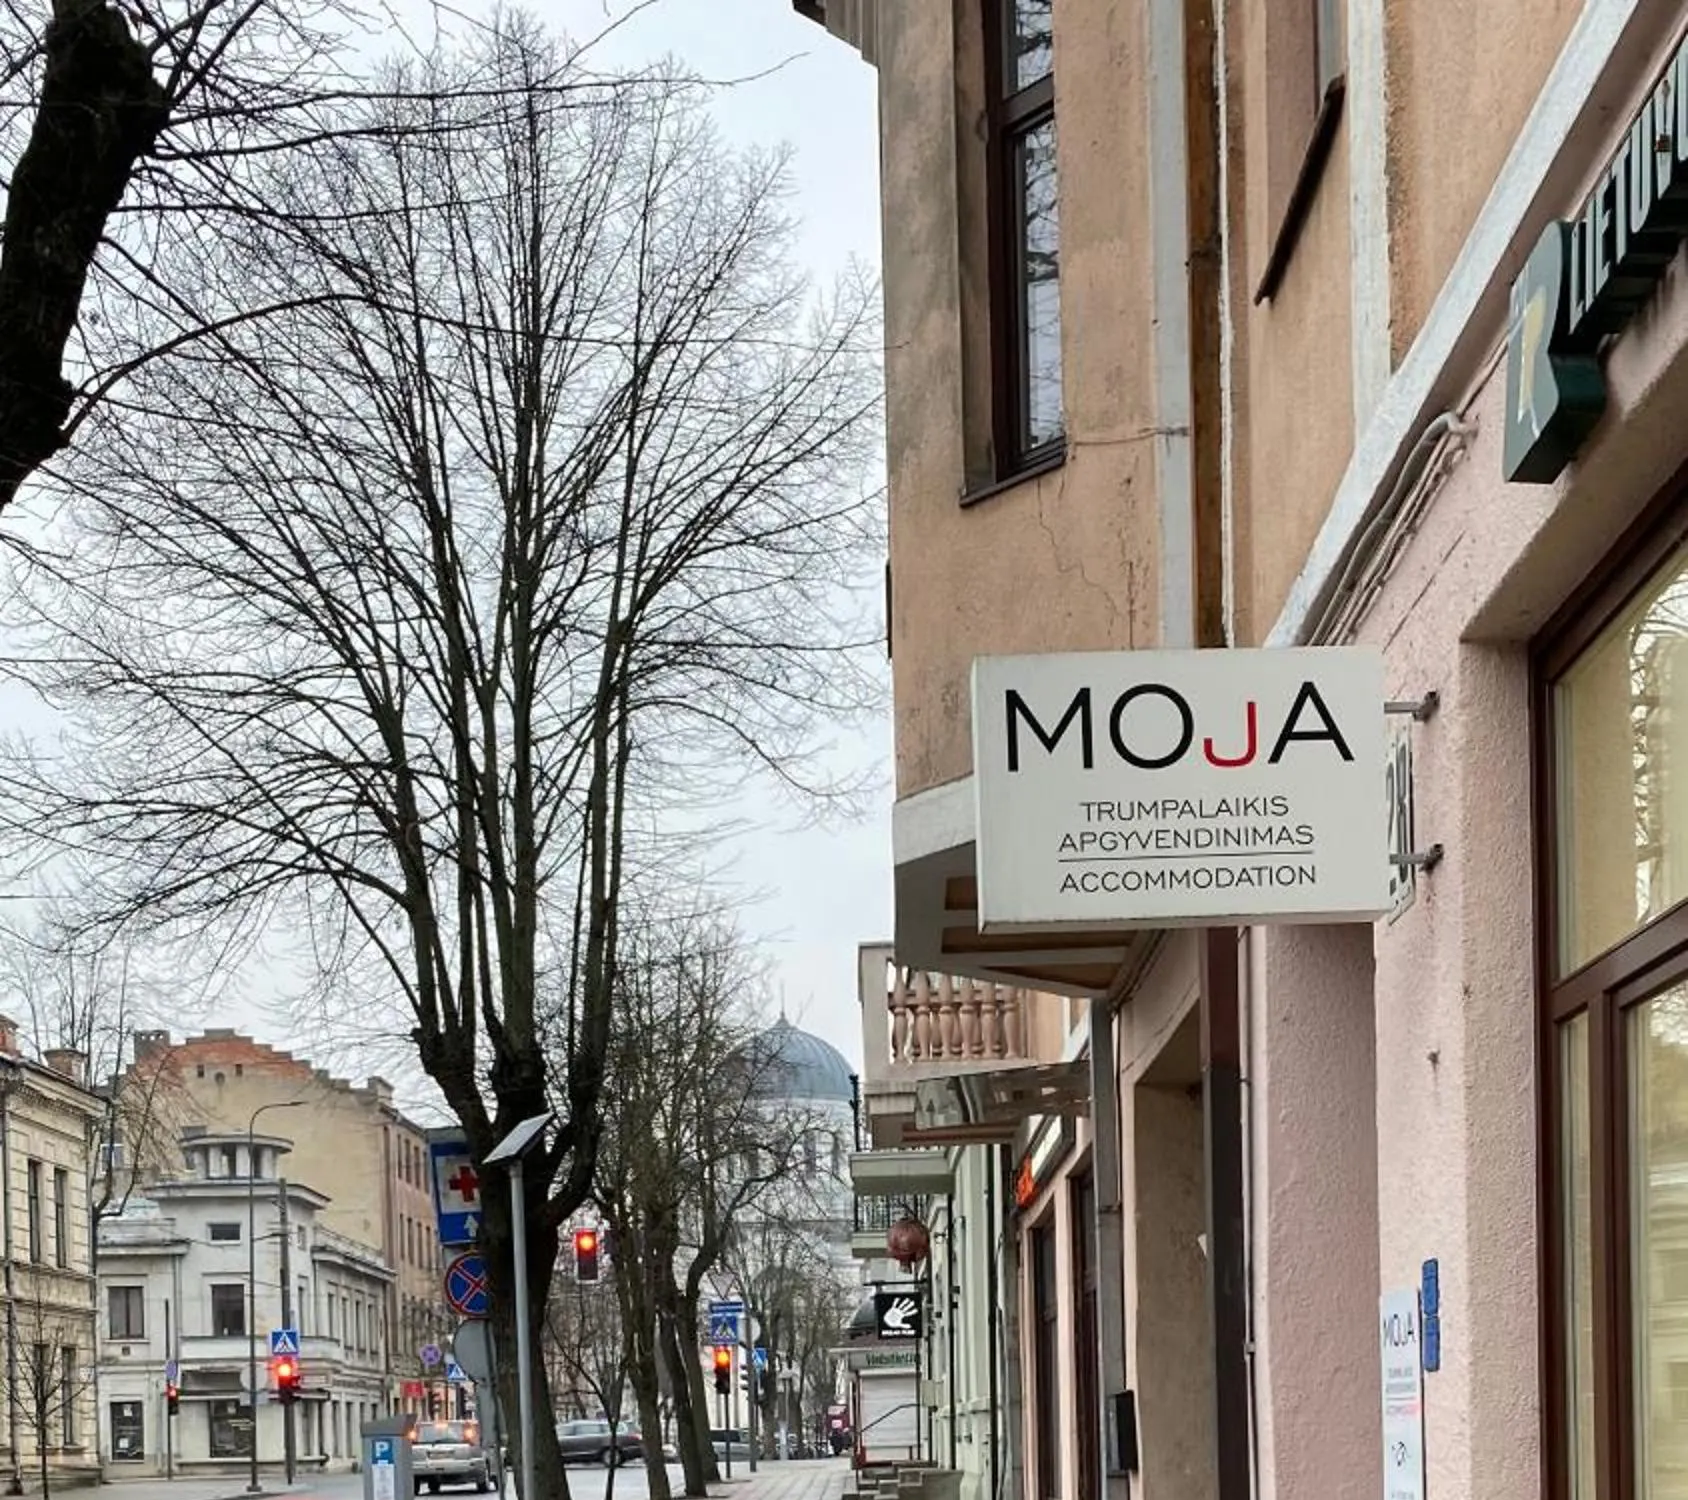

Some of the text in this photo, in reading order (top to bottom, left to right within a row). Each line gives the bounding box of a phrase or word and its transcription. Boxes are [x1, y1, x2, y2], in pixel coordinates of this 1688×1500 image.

[1004, 680, 1355, 773] MOJA
[1079, 795, 1289, 823] TRUMPALAIKIS
[1058, 824, 1315, 853] APGYVENDINIMAS
[1059, 864, 1317, 894] ACCOMMODATION
[375, 1441, 390, 1458] P
